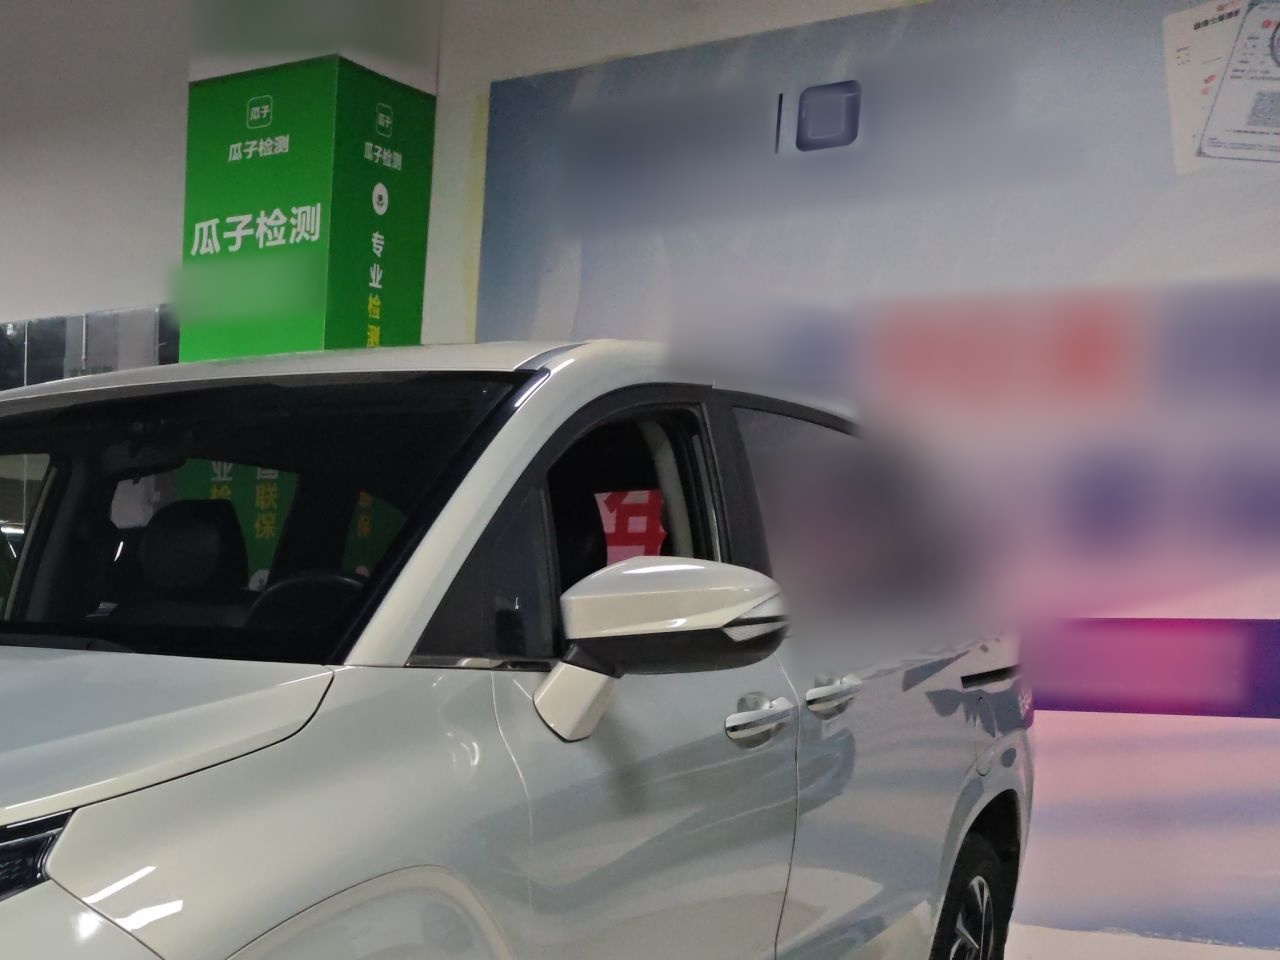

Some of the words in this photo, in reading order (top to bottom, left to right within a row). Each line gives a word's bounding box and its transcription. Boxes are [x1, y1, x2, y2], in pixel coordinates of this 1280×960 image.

[249, 104, 271, 121] 瓜子
[228, 134, 290, 163] 瓜子检测
[364, 141, 403, 172] 瓜子检测
[190, 202, 322, 257] 瓜子检测
